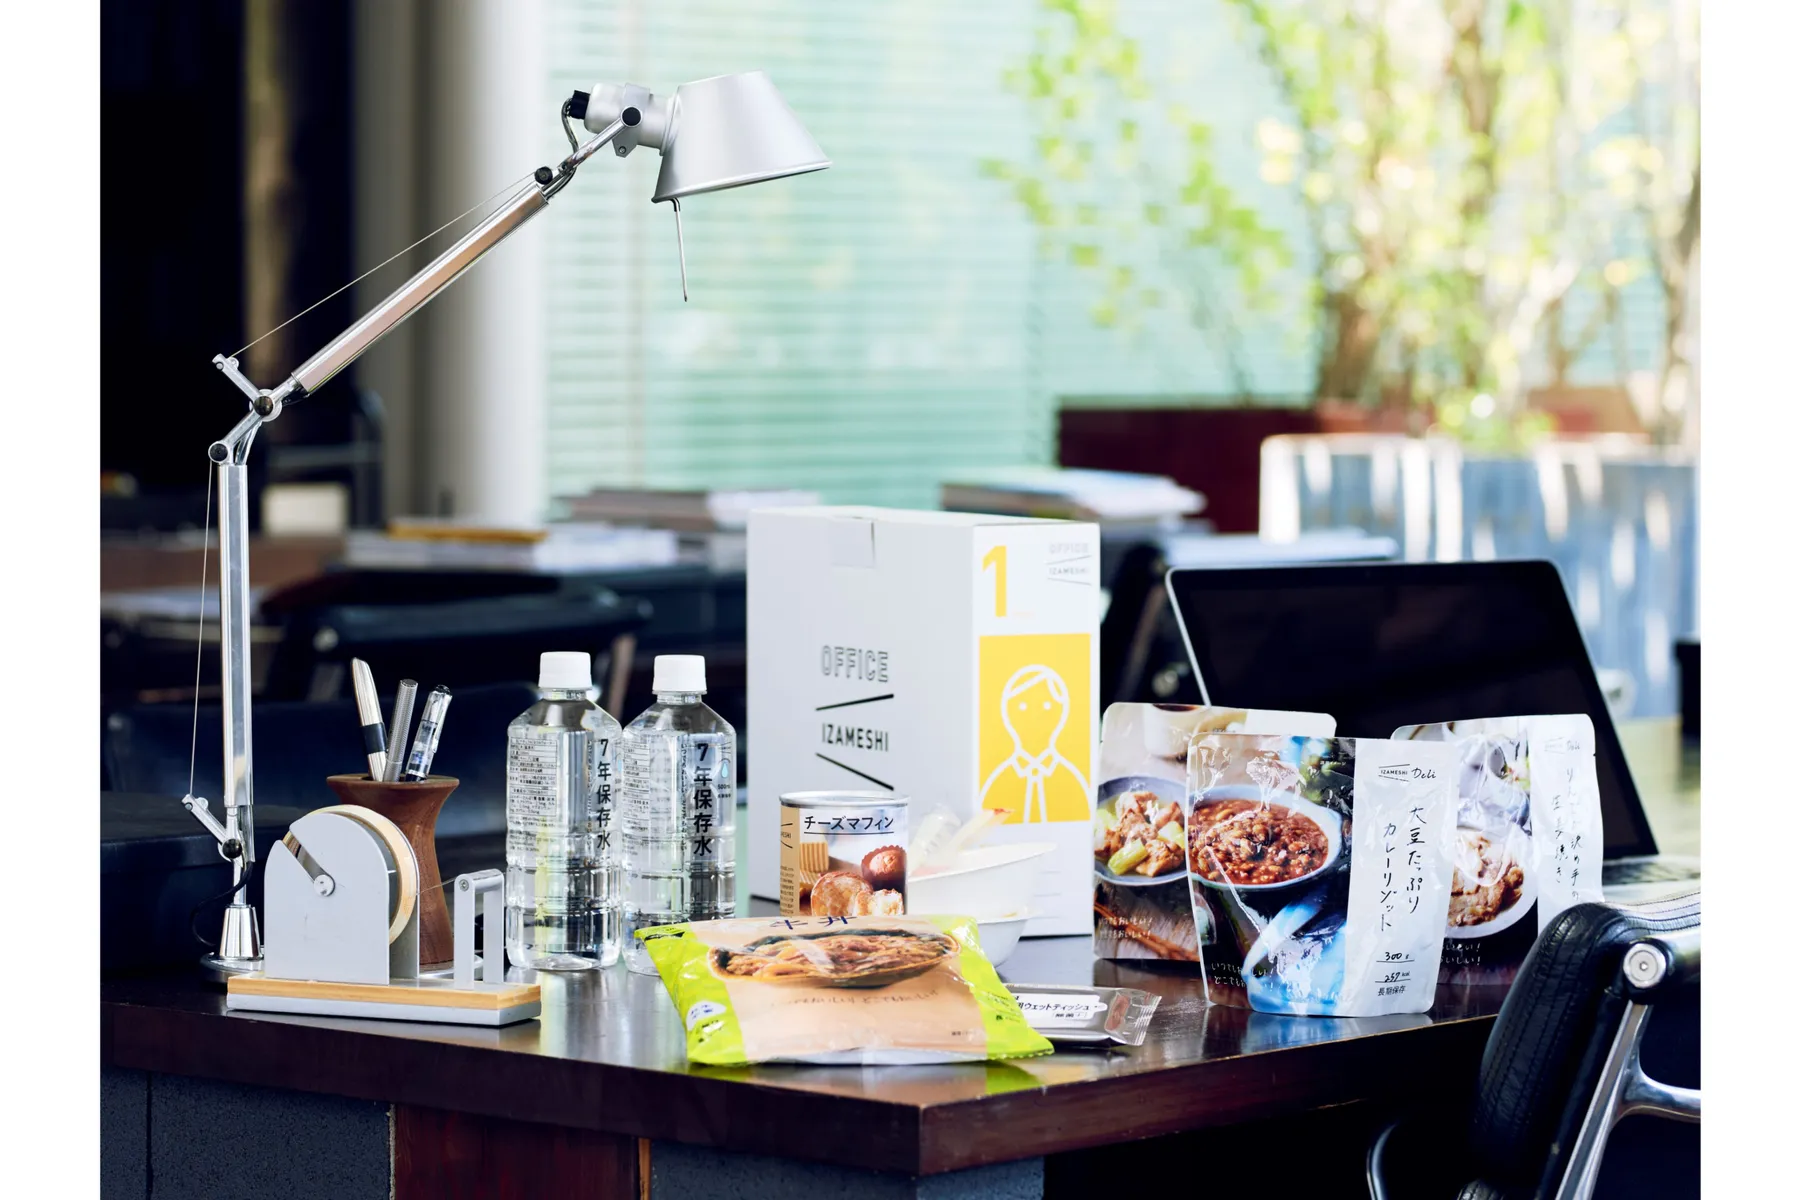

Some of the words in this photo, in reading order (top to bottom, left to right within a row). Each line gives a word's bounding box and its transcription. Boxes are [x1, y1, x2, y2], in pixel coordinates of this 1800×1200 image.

[981, 544, 1007, 618] 1
[821, 645, 889, 683] OFFICE
[821, 722, 889, 752] IZAMESHI
[1411, 767, 1437, 779] Deli
[596, 738, 612, 851] 7年保存水
[693, 743, 713, 856] 7年保存水
[803, 815, 895, 830] チーズマフィン
[1380, 822, 1398, 931] カレーリゾット
[1407, 806, 1427, 914] 大豆たっぷり
[1384, 951, 1402, 961] 300
[1377, 985, 1406, 997] 長期保存
